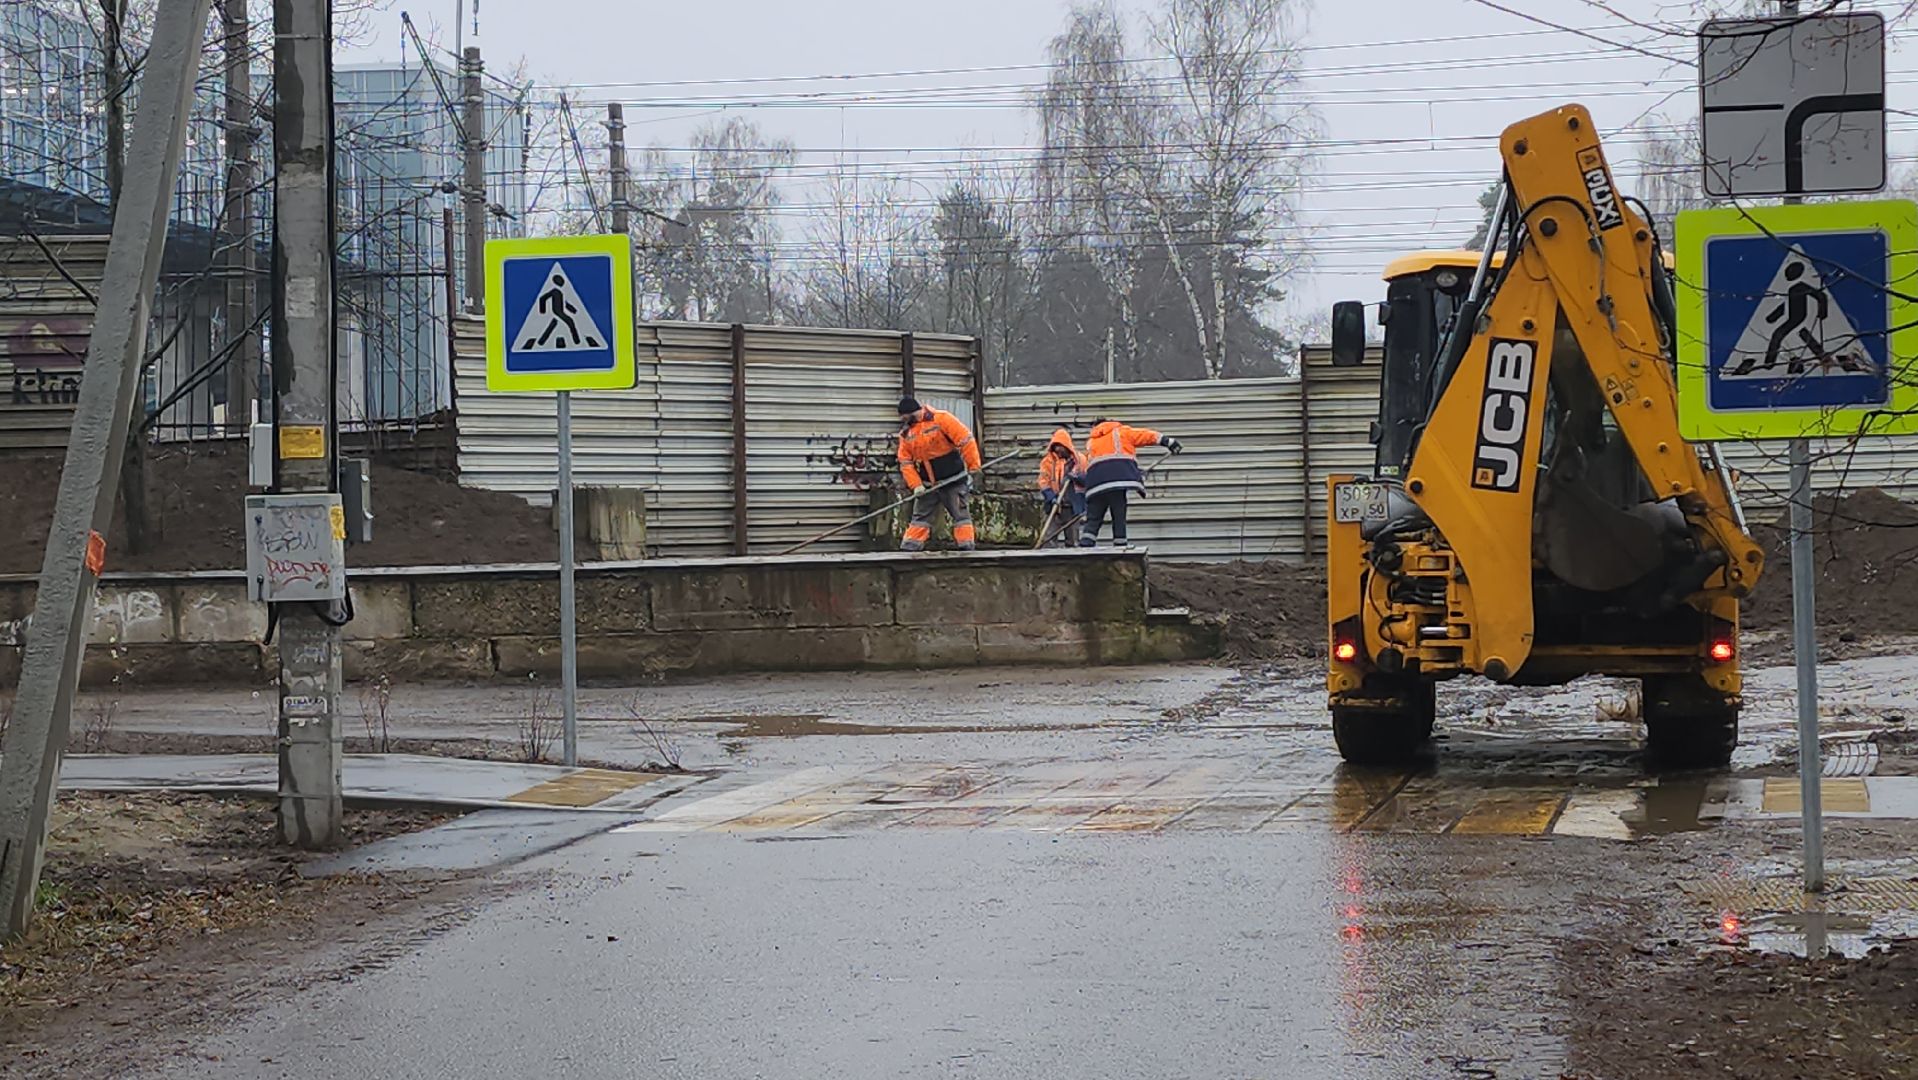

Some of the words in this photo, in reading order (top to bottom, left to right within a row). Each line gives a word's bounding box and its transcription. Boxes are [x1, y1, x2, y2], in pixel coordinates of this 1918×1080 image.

[1585, 168, 1620, 222] 3CX
[1478, 342, 1533, 488] JCB
[1342, 486, 1381, 501] 5097
[1368, 503, 1385, 515] 50
